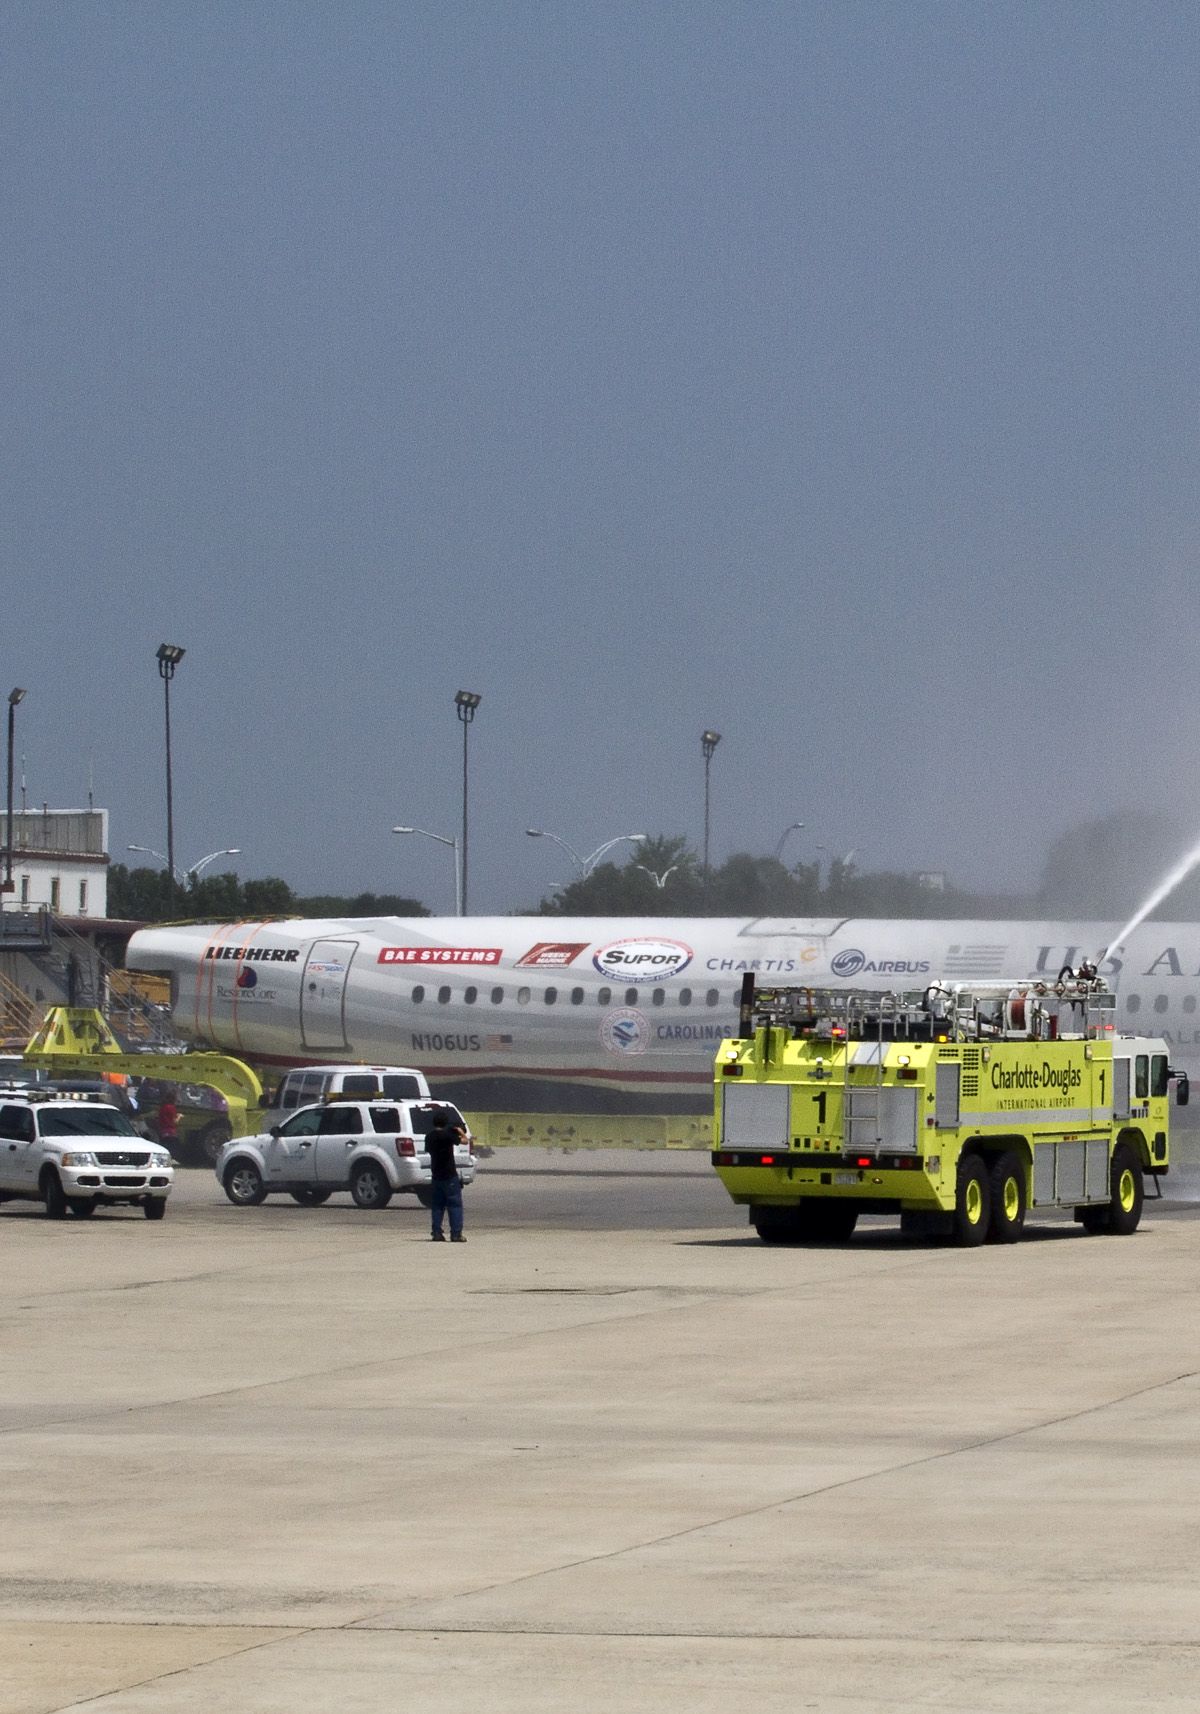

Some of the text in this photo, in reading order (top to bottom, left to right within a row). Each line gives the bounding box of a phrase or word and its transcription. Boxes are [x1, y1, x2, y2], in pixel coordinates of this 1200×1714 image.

[205, 946, 300, 963] LIEBHERR
[384, 950, 496, 962] BAE SYSTEMS
[602, 950, 682, 965] SUPOR
[706, 958, 797, 972] CHARTIS
[863, 960, 930, 974] AIRBUS
[656, 1024, 733, 1040] CAROLINAS
[411, 1033, 481, 1051] N106US
[1098, 1069, 1105, 1105] 1
[812, 1091, 827, 1124] 1
[996, 1097, 1075, 1110] INTERNATIONAL AIRPORT
